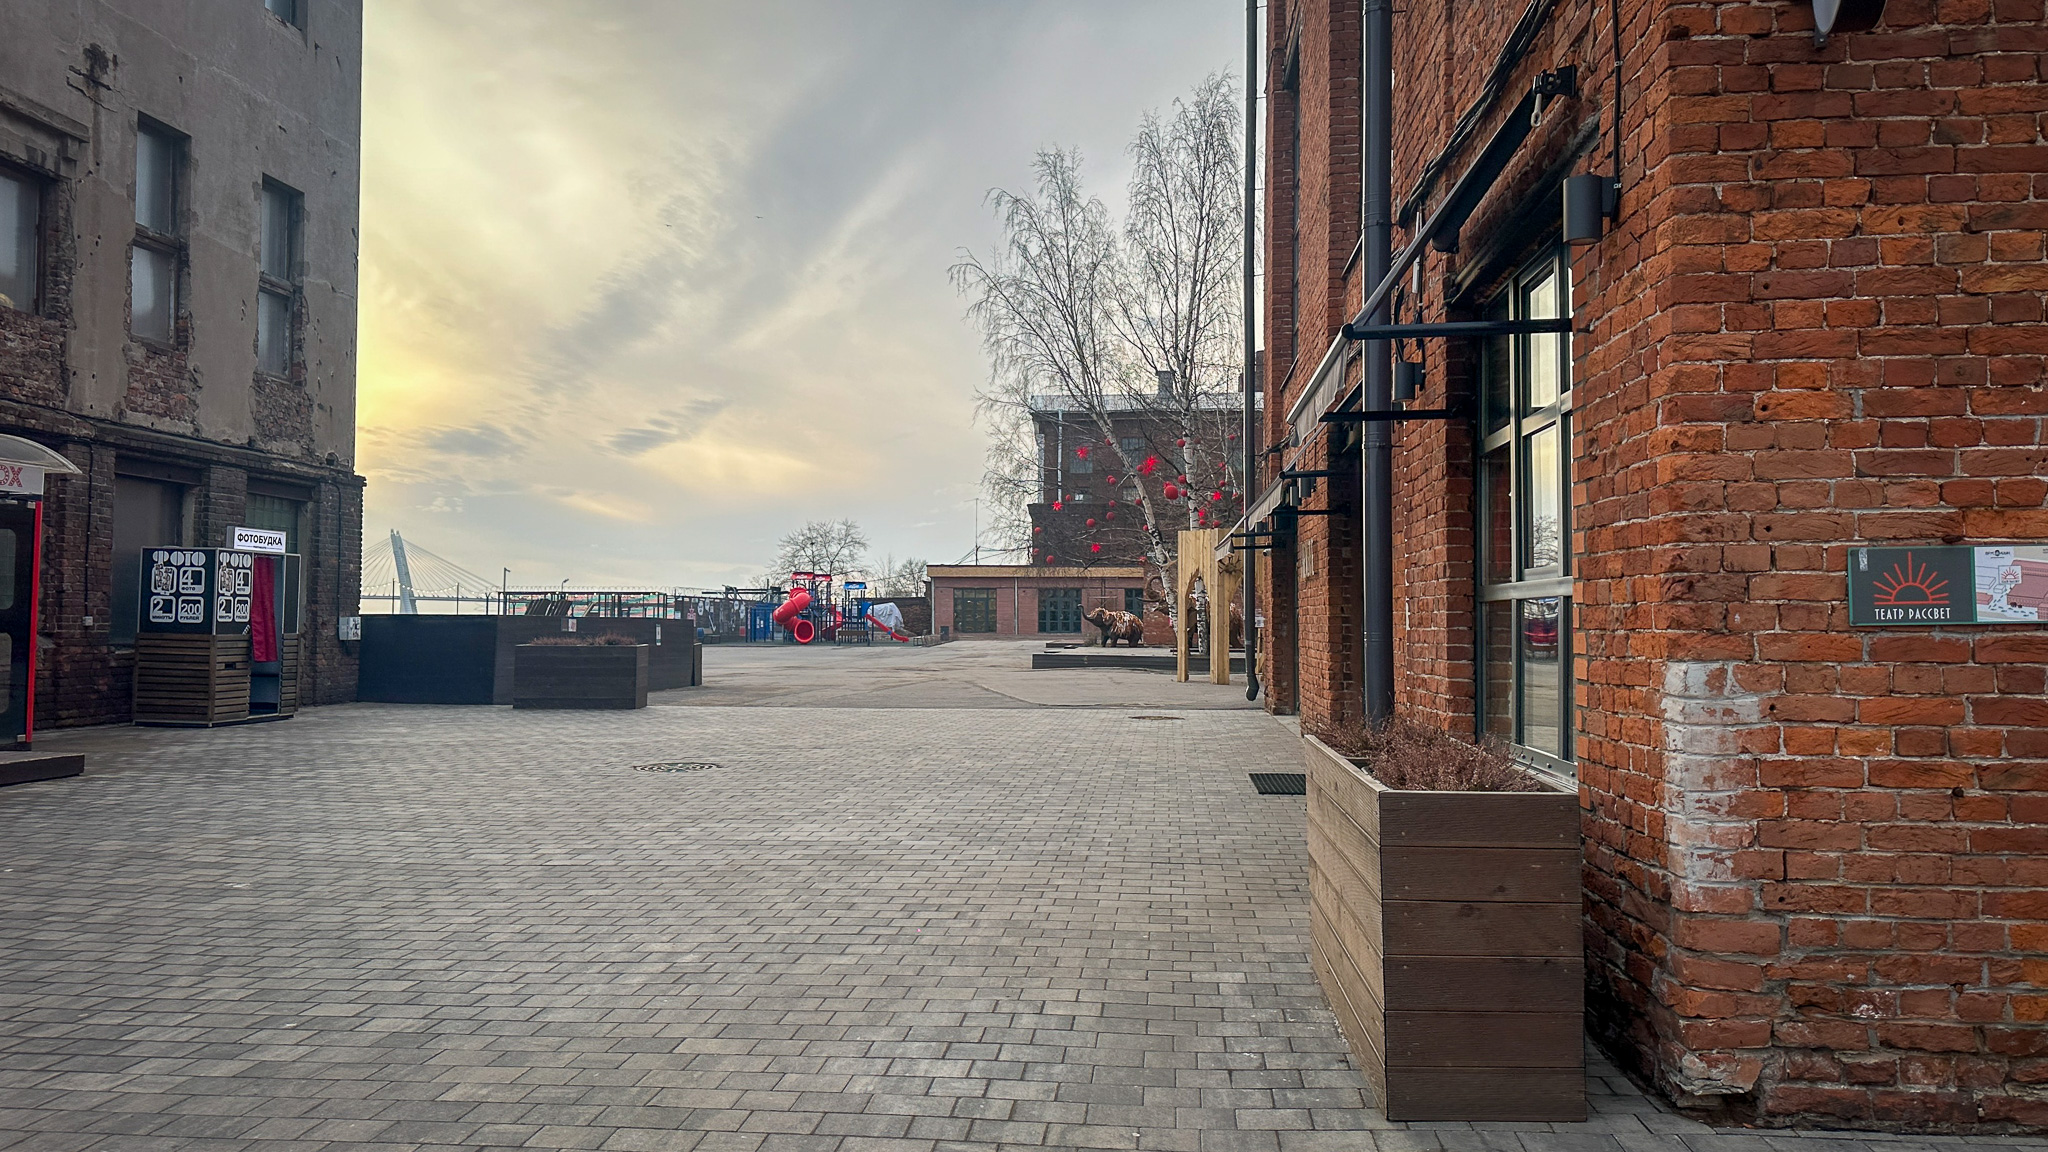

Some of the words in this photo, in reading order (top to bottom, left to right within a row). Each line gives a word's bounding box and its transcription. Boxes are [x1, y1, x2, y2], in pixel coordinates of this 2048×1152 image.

[237, 533, 283, 546] ФОТОБУДКА
[152, 551, 206, 566] ФОТО
[219, 552, 251, 568] ФОТО
[181, 569, 194, 587] 4
[236, 571, 244, 588] 4
[153, 598, 164, 614] 2
[181, 603, 201, 615] 200
[219, 599, 226, 614] 2
[236, 603, 249, 615] 200
[1874, 608, 1904, 620] ТЕАТР
[1908, 608, 1951, 620] РАССВЕТ
